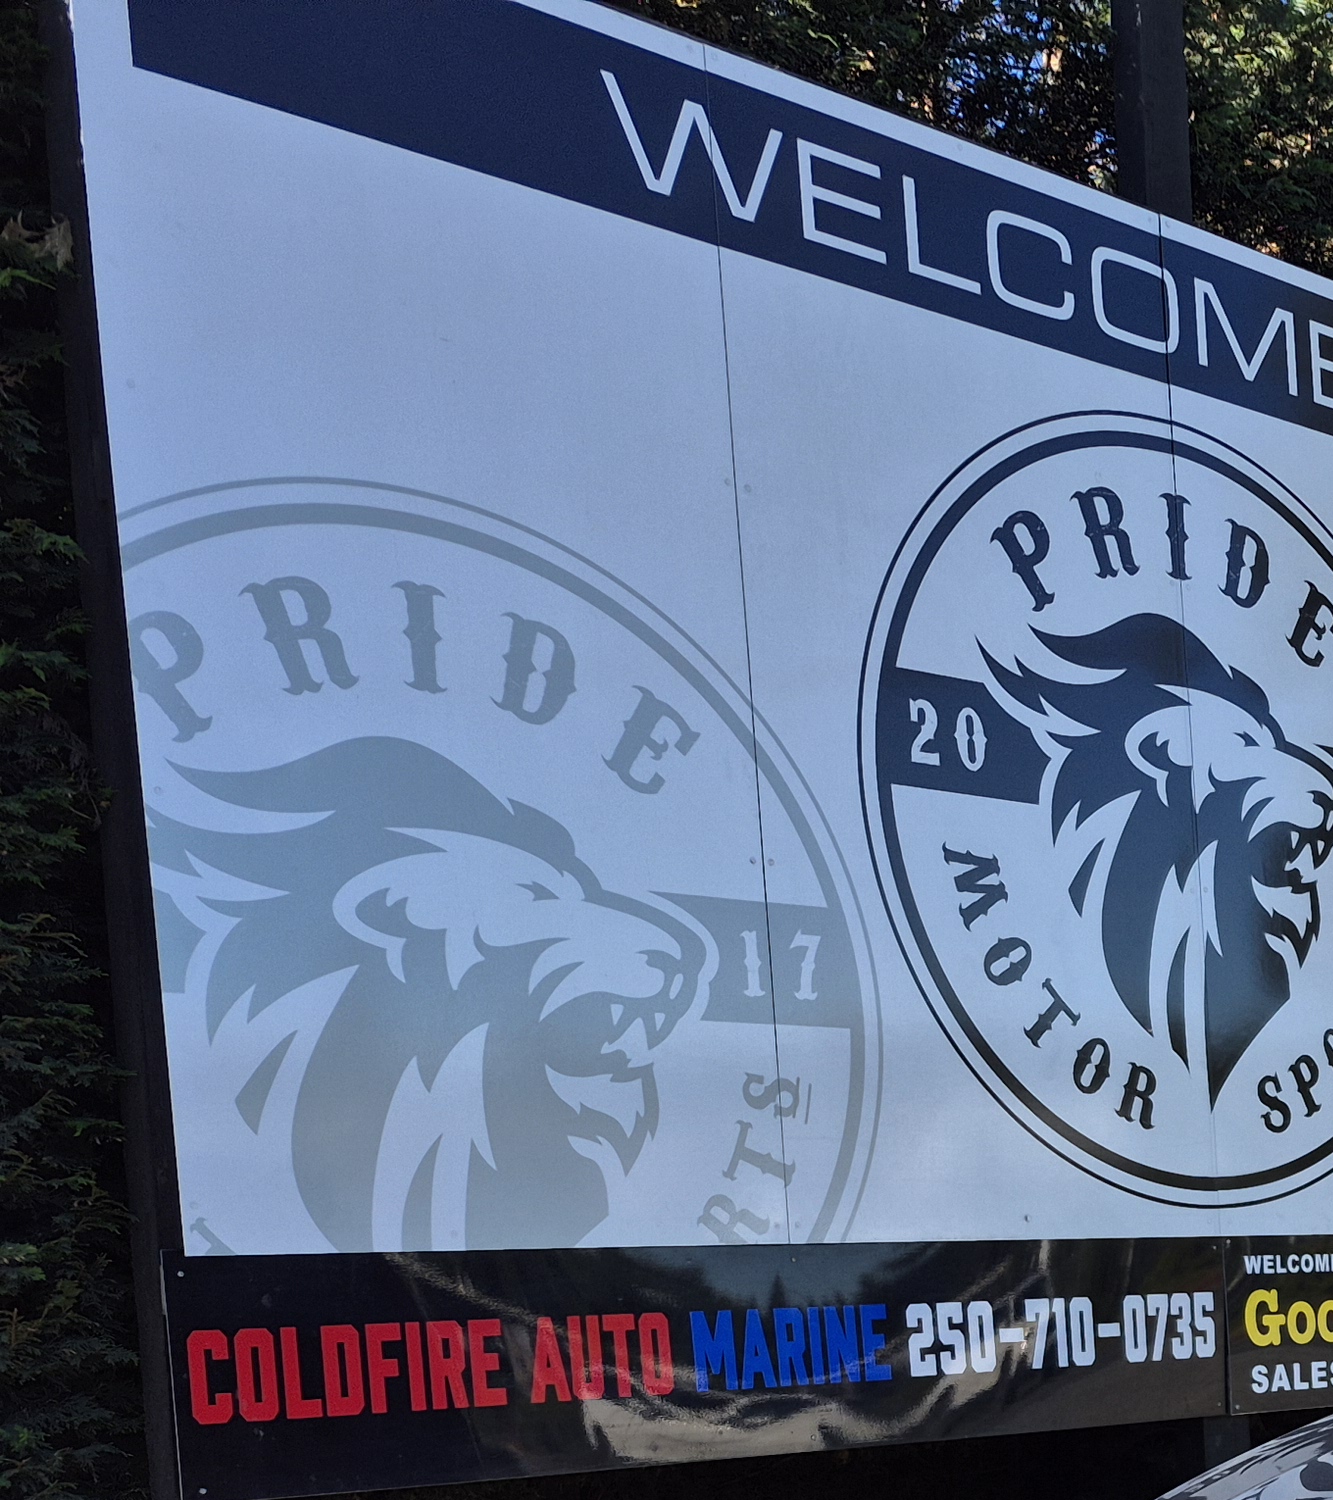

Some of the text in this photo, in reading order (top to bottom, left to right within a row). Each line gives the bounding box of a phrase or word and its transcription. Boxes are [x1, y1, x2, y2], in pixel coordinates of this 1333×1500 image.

[127, 576, 701, 795] PRIDE
[909, 698, 988, 772] 20
[740, 929, 821, 1000] 17
[942, 841, 1155, 1129] MOTOR
[186, 1291, 1217, 1425] COLDFIRE AUTO MARINE 250-710-0735
